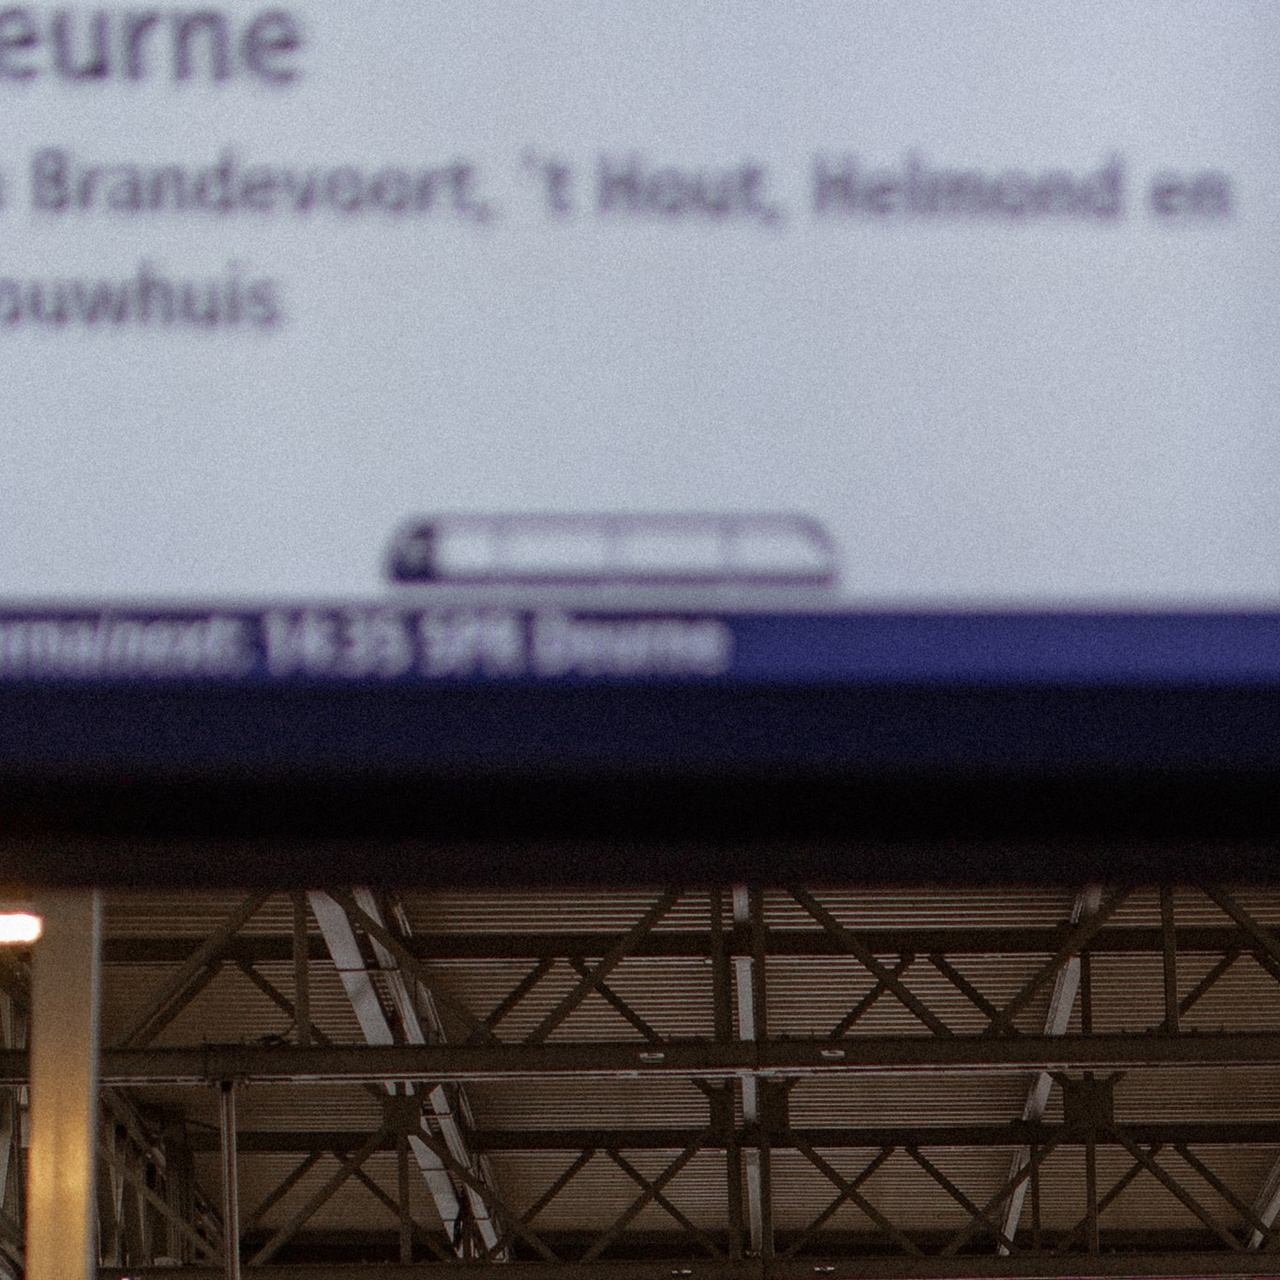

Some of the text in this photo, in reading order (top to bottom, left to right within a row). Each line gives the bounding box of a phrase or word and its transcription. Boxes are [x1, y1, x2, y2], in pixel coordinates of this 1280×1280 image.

[30, 147, 497, 224] Brandevoort,
[598, 151, 785, 226] Hout,
[811, 149, 1123, 221] Helmond
[1151, 170, 1232, 221] en
